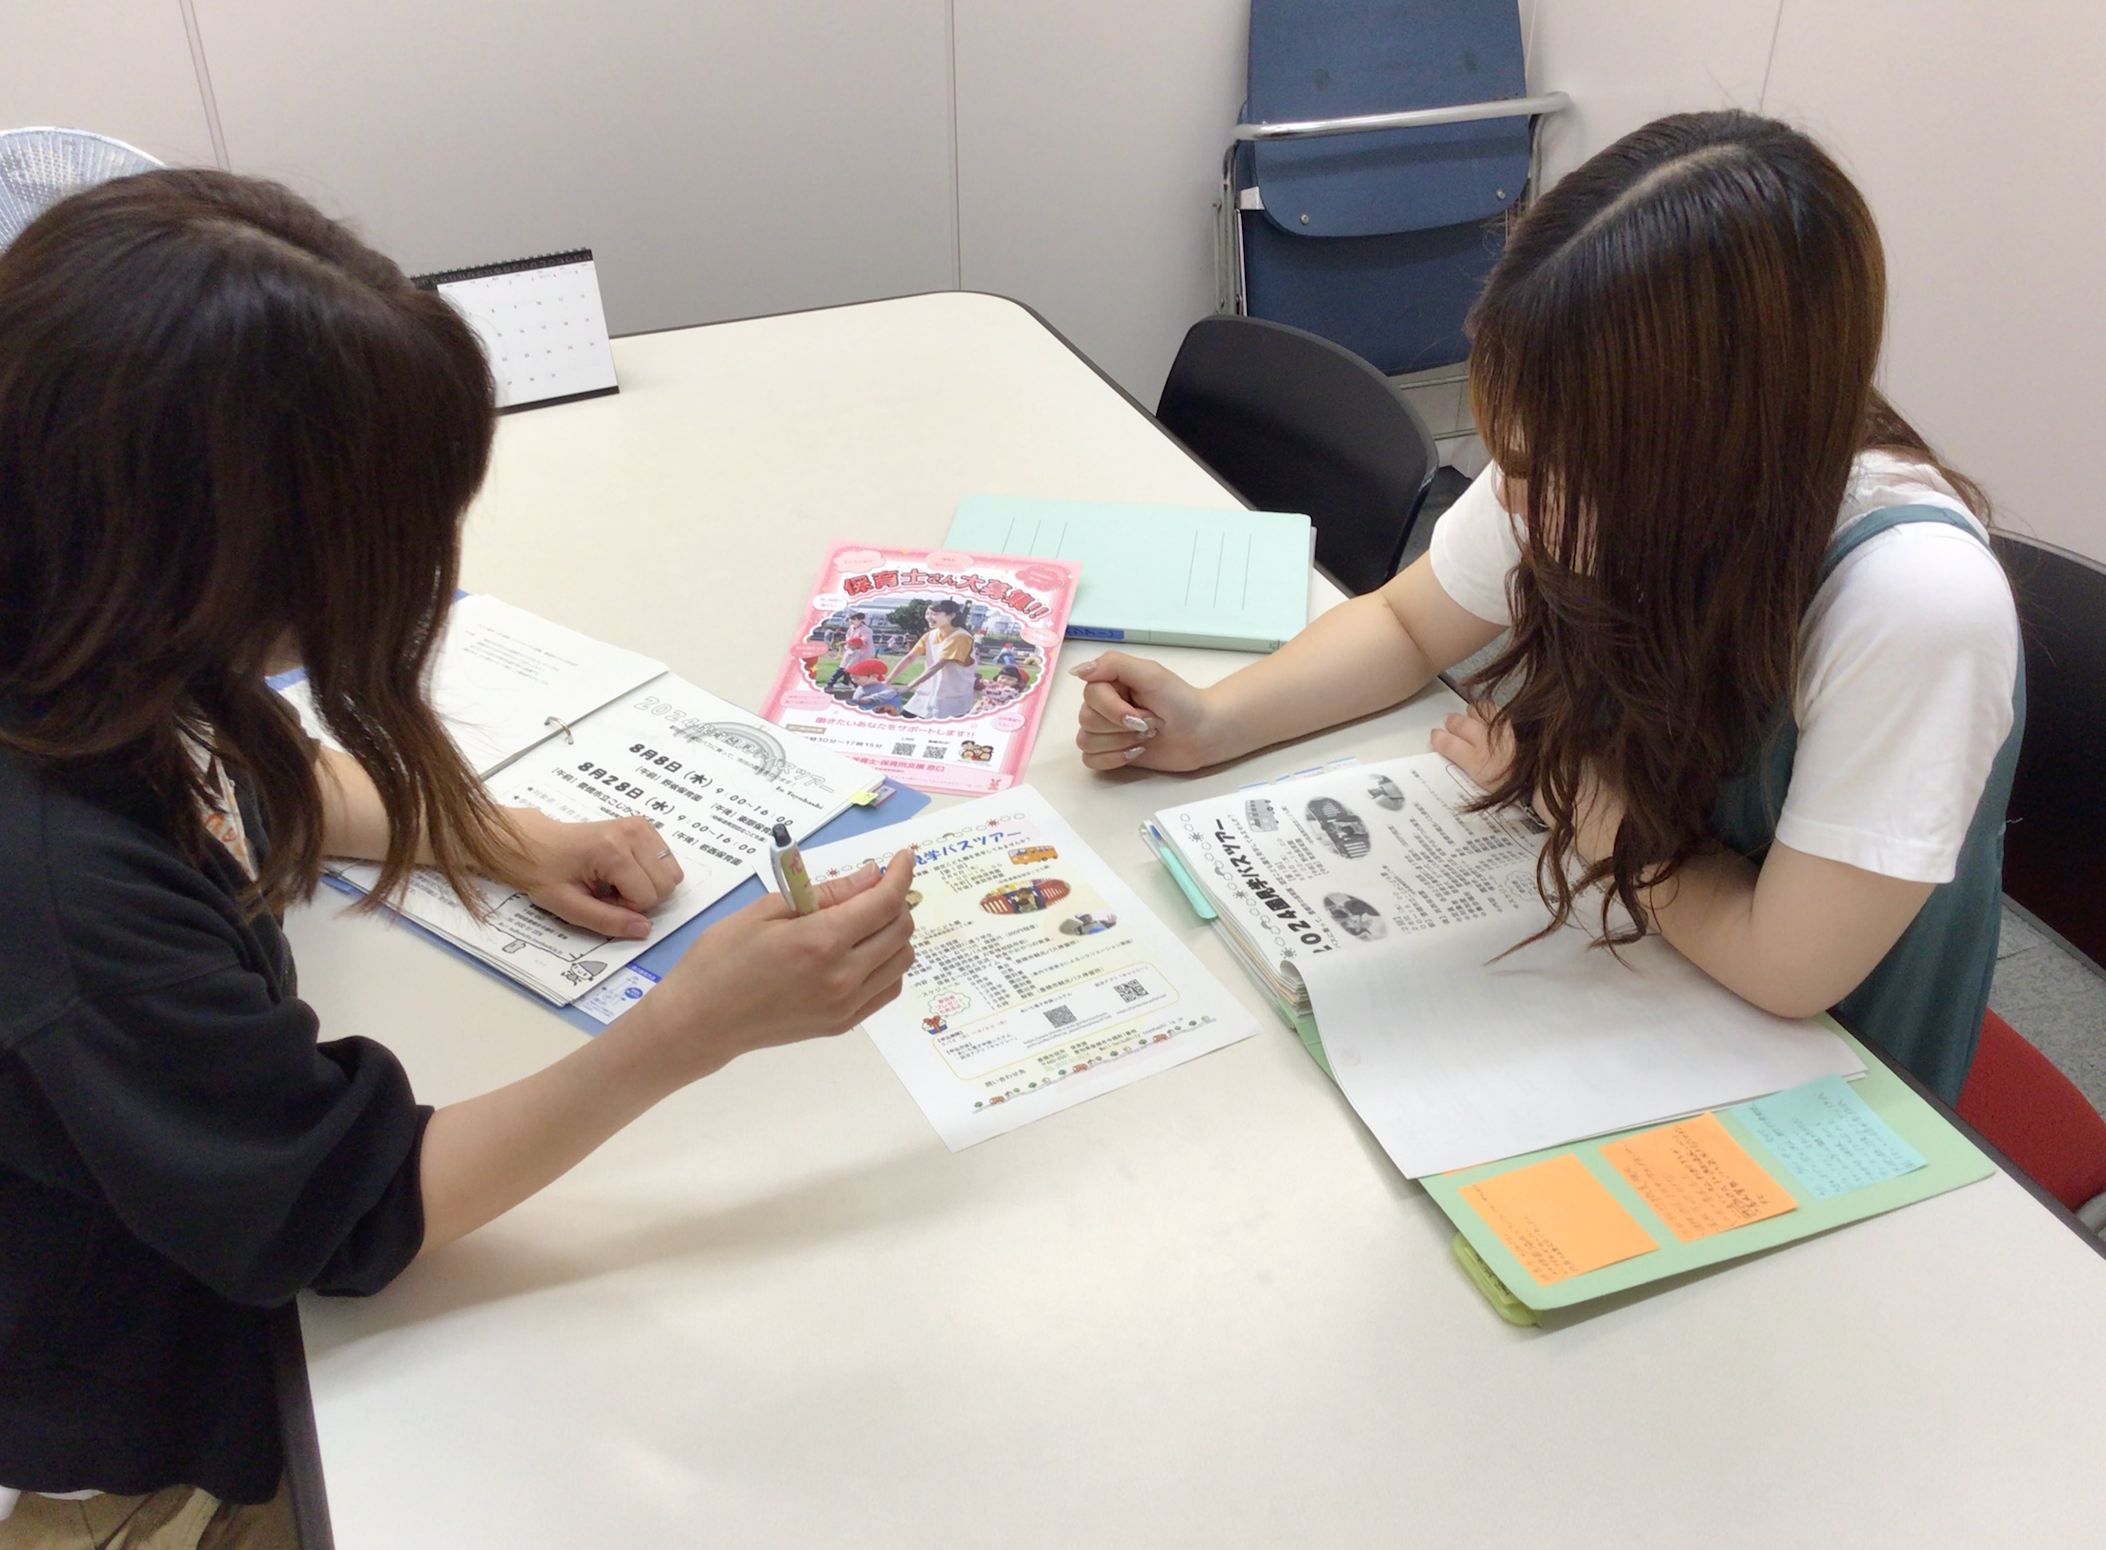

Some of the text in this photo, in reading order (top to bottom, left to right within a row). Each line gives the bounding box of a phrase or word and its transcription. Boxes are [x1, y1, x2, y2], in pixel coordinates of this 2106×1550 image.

[842, 567, 1051, 620] 保育士さん大募集!!
